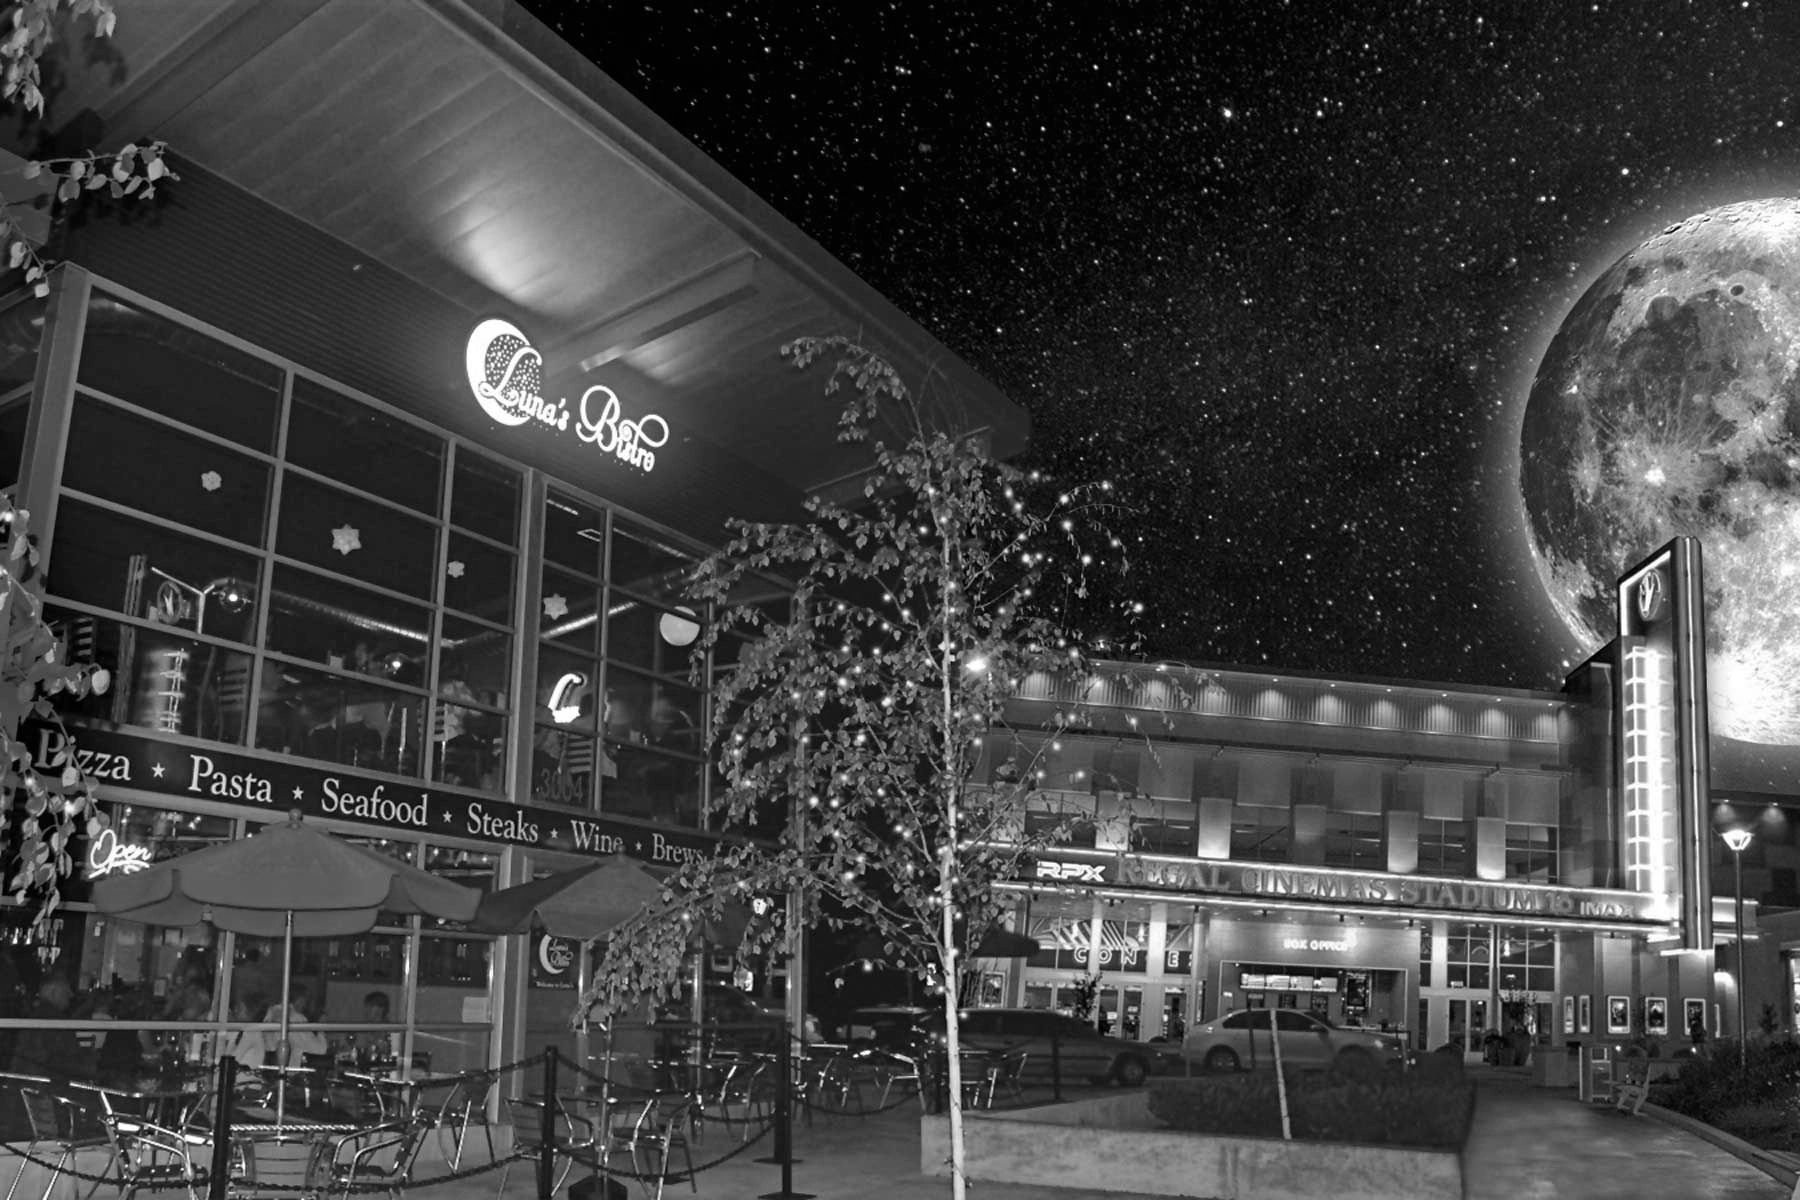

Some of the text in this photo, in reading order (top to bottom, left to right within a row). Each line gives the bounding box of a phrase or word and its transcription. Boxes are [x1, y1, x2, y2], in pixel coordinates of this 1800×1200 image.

[479, 347, 669, 472] Luna's Bistro
[188, 754, 272, 803] Pasta
[321, 778, 428, 826] Seafood
[467, 802, 538, 843] Steaks
[571, 820, 624, 853] Wine
[90, 829, 152, 879] Open
[1037, 860, 1106, 882] RPX
[1241, 869, 1388, 900] CINEMAS
[1400, 879, 1539, 911] STADIUM
[1074, 947, 1193, 968] CONE
